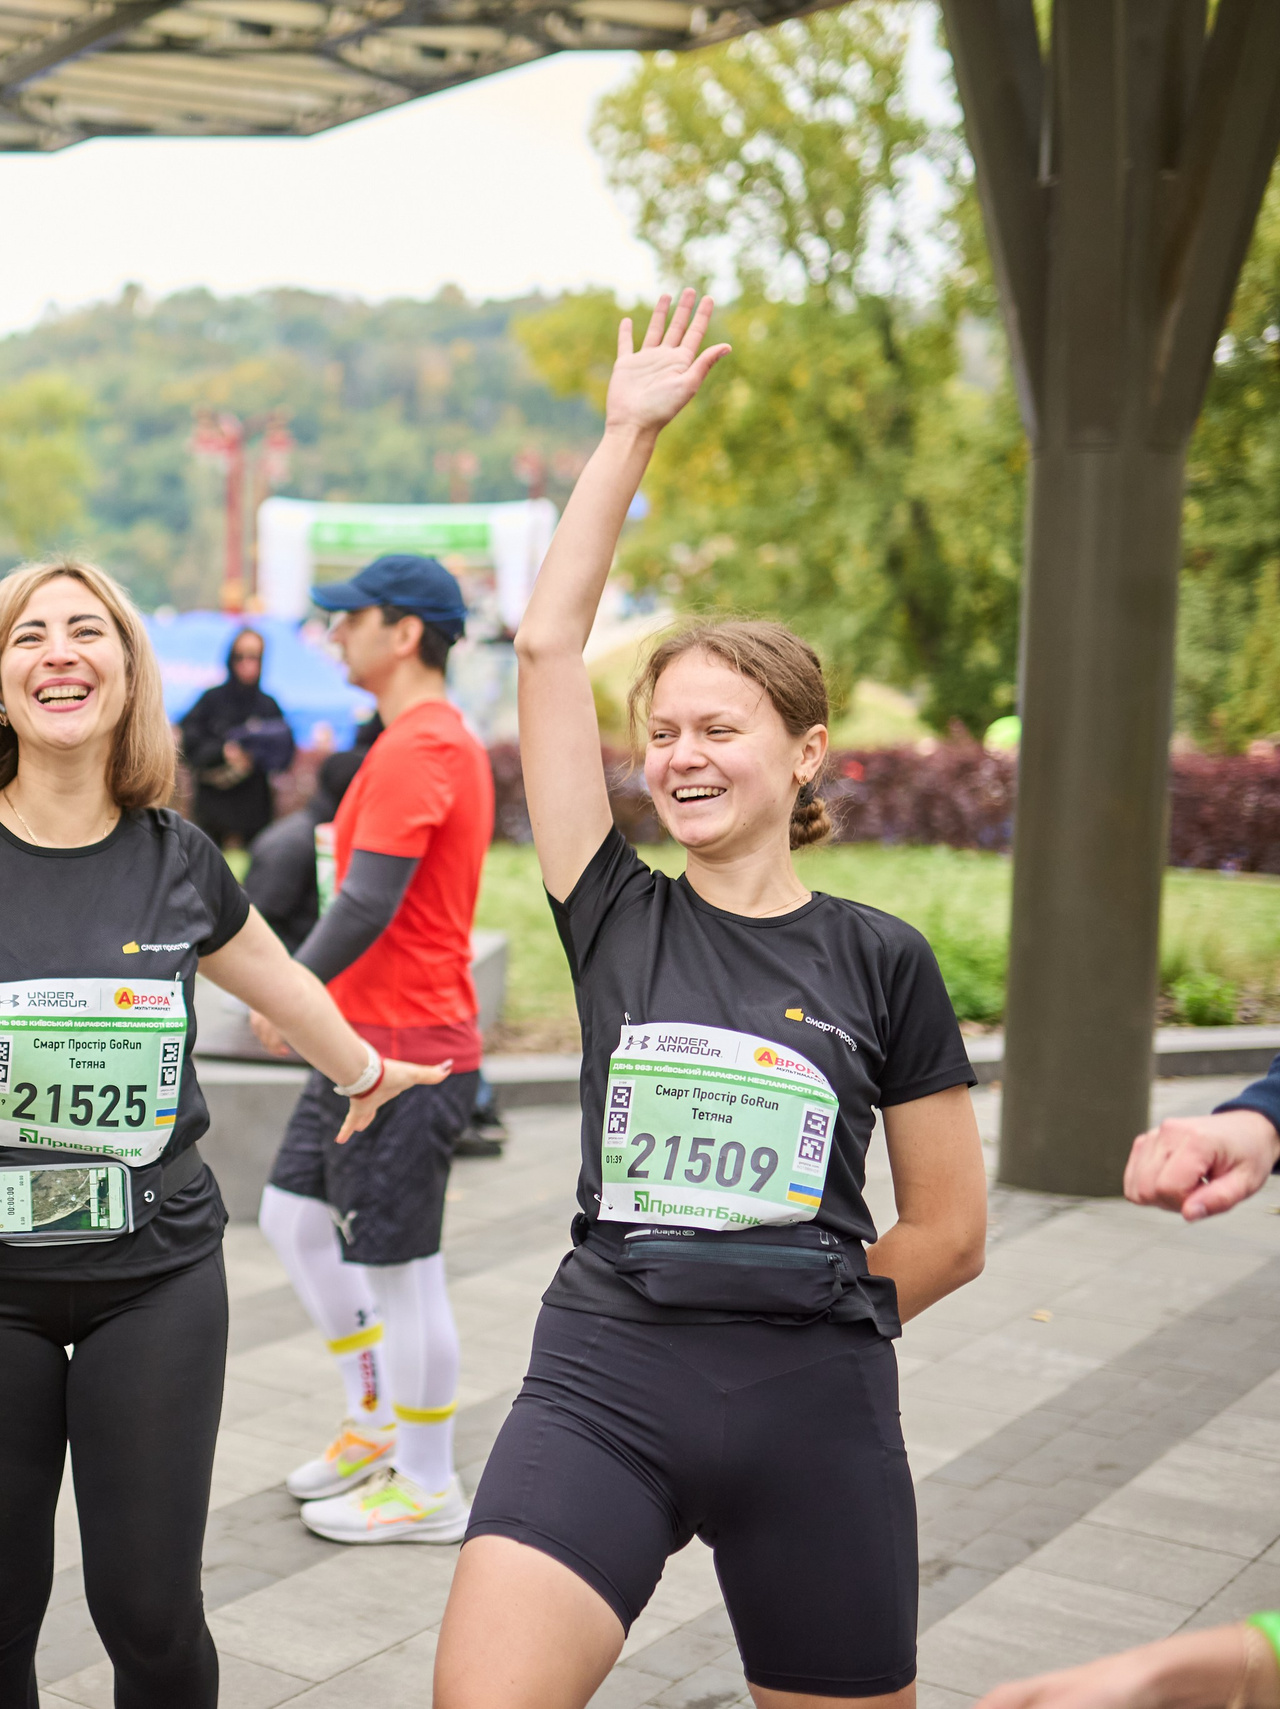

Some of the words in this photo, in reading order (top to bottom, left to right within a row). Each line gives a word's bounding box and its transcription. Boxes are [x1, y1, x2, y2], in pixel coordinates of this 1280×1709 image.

[27, 991, 74, 999] UNDER
[117, 991, 170, 1006] АВРОРА
[27, 999, 87, 1008] ARMOUR
[29, 1019, 73, 1027] КИЇВСЬКИЙ
[805, 1016, 836, 1033] смарт
[33, 1038, 65, 1052] Смарт
[68, 1038, 106, 1052] Простір
[109, 1038, 142, 1050] GoRun
[657, 1035, 709, 1047] UNDER
[655, 1044, 721, 1057] ARMOUR
[69, 1058, 106, 1069] Тетяна
[654, 1065, 701, 1076] КИЇВСЬКИЙ
[702, 1070, 746, 1082] МАРАФОН
[747, 1077, 812, 1094] НЕЗЛАМНОСТІ
[12, 1082, 148, 1127] 21525
[655, 1084, 690, 1100] Смарт
[692, 1087, 737, 1105] Простір
[740, 1093, 780, 1111] GoRun
[691, 1107, 733, 1124] Тетяна
[40, 1136, 142, 1157] ПриватБанк
[605, 1155, 622, 1164] 01:39
[627, 1132, 779, 1193] 21509
[650, 1199, 764, 1226] ПриватБанк
[652, 1228, 682, 1237] Kalenji
